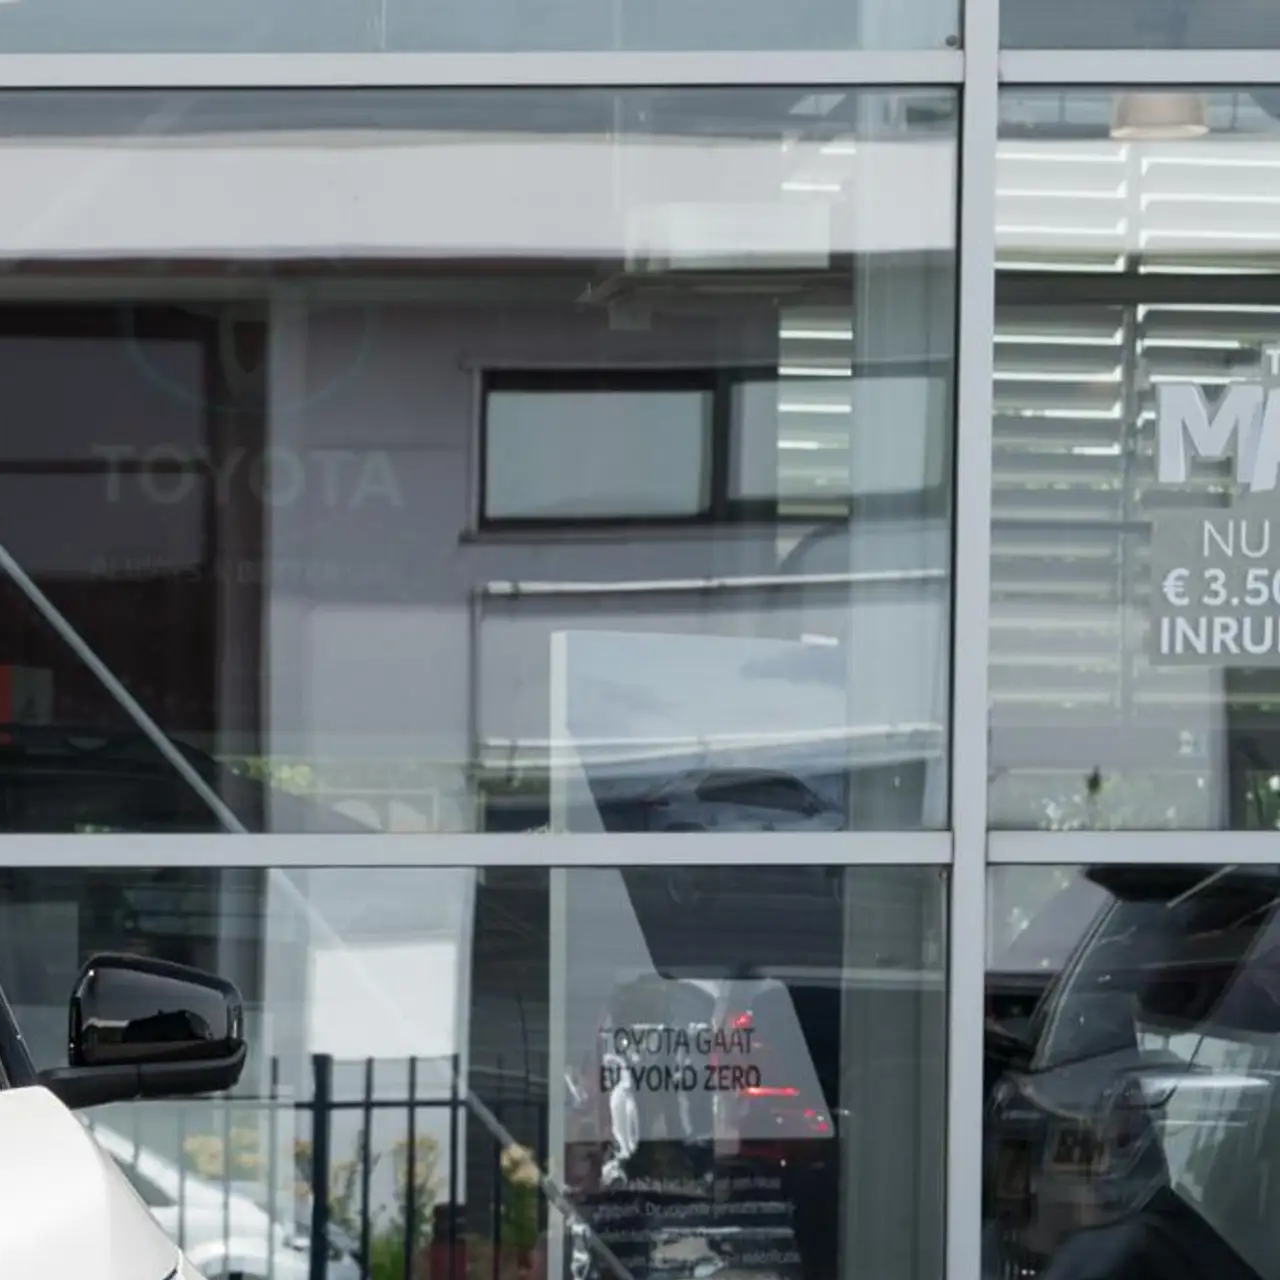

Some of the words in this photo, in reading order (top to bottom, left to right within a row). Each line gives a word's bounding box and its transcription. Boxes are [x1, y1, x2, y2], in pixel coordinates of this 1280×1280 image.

[90, 443, 406, 510] TOYOTA
[1203, 519, 1270, 558] NU
[696, 1027, 756, 1056] GAAT
[704, 1064, 762, 1092] ZERO
